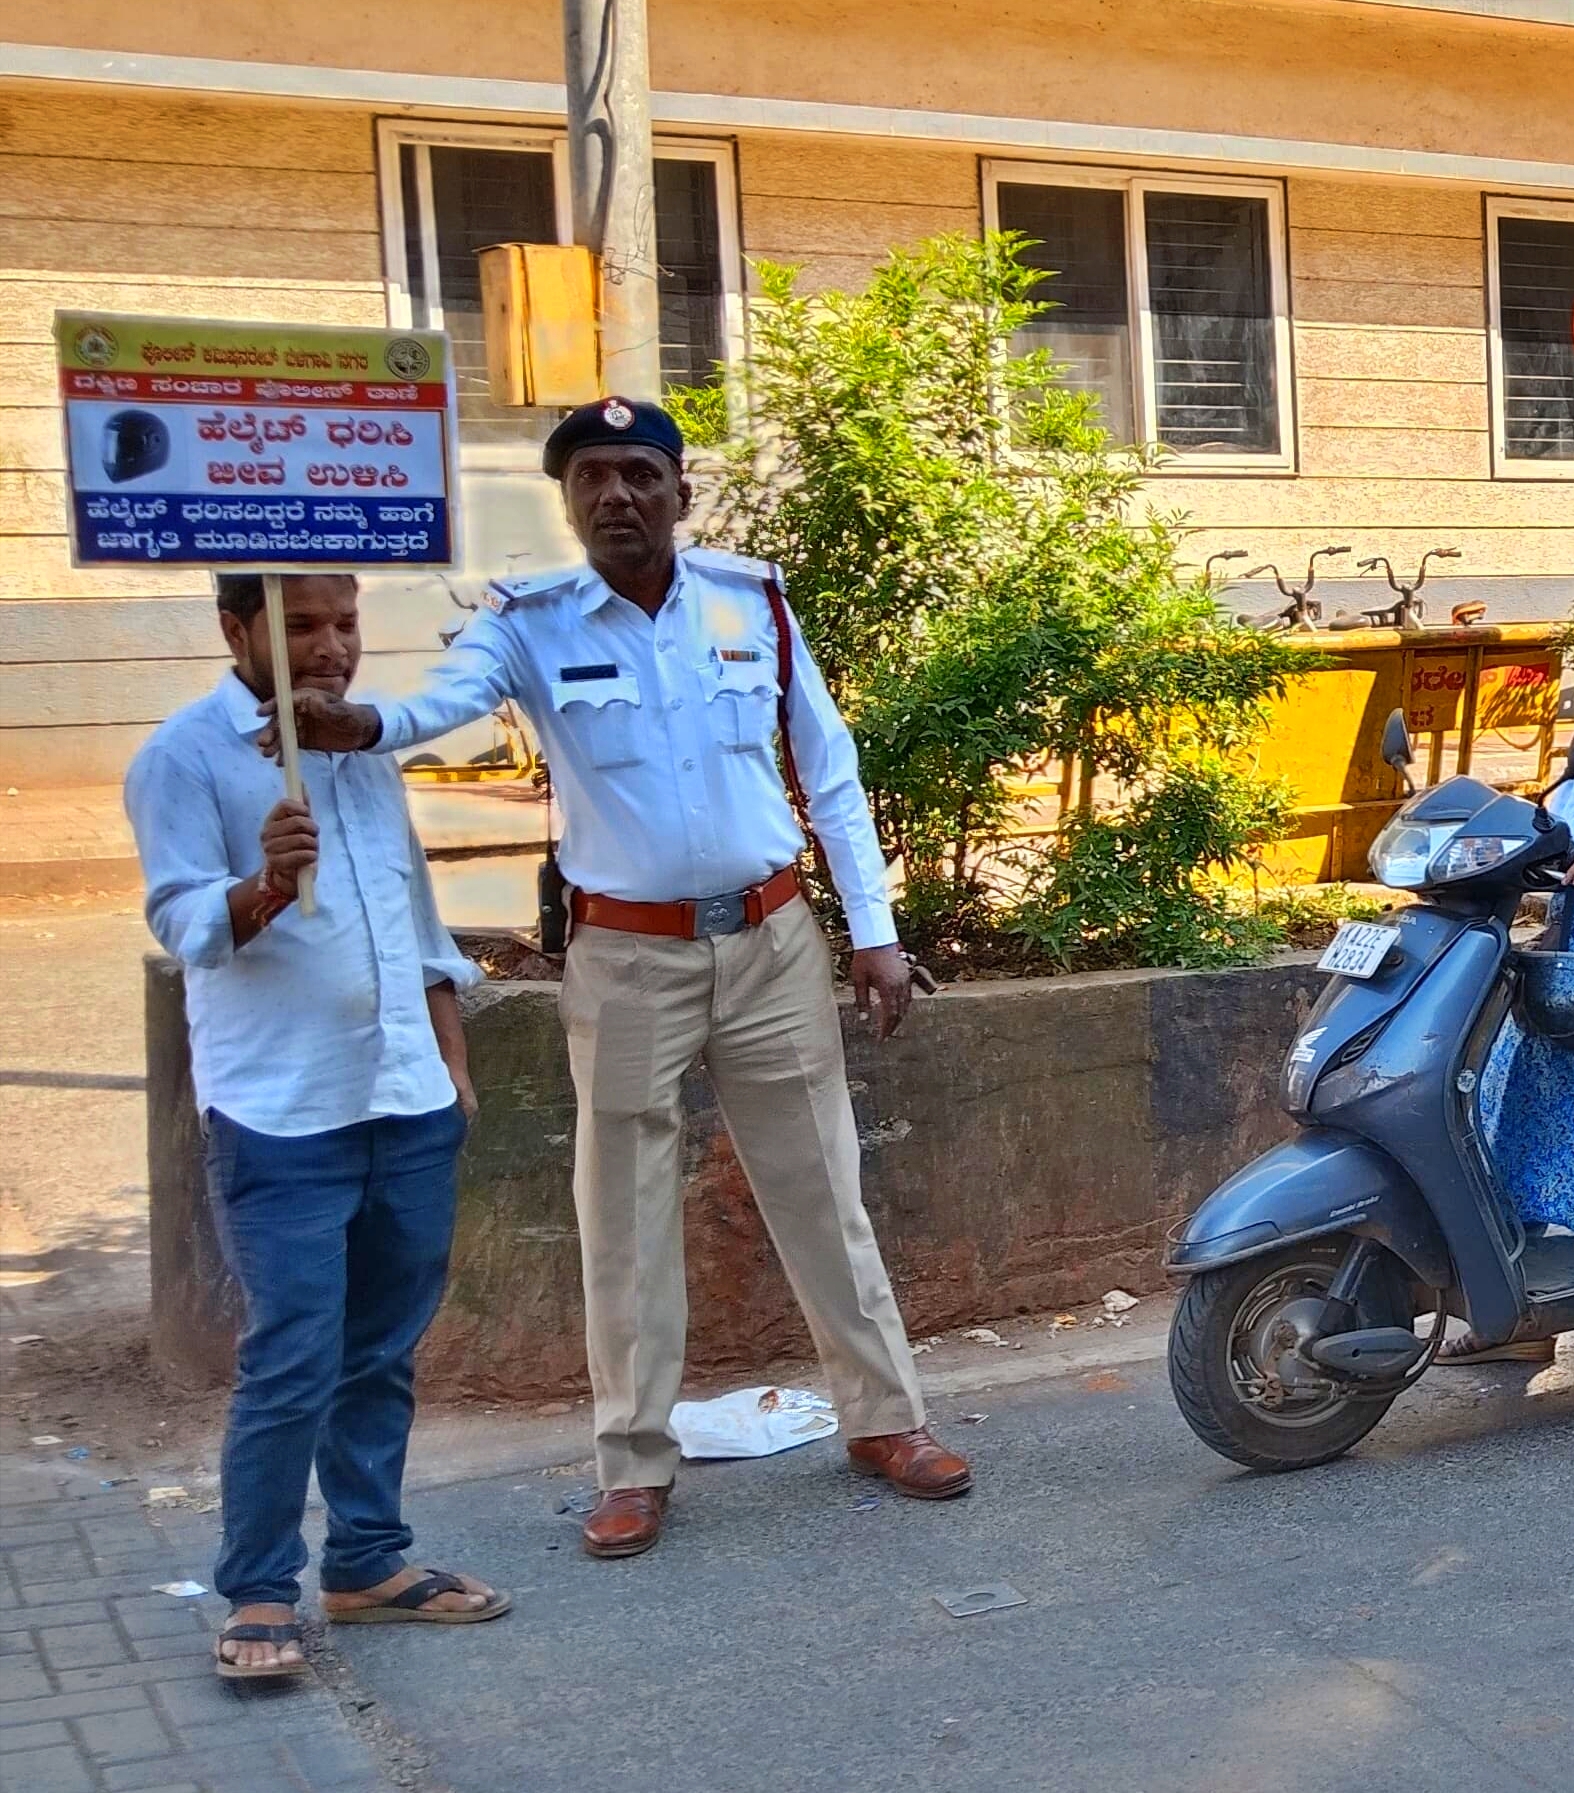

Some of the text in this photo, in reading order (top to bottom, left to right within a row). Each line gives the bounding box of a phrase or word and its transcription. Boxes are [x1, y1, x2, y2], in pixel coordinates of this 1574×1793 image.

[151, 376, 242, 395] ಸಂಚಾರ
[197, 411, 414, 454] ಹೆಲ್ಮೆಟ್ ಧರಿಸಿ
[207, 455, 409, 487] ಜೀವ ಉಳಿಸಿ
[86, 497, 435, 529] ಹೆಲ್ಮೆಟ್ ಧರಿಸದಿದ್ದರೆ ನಮ್ಮ ಹಾಗೆ
[97, 529, 429, 558] ಜಾಗೃತಿ ಮೂಡಿಸಬೇಕಾಗುತ್ತದೆ
